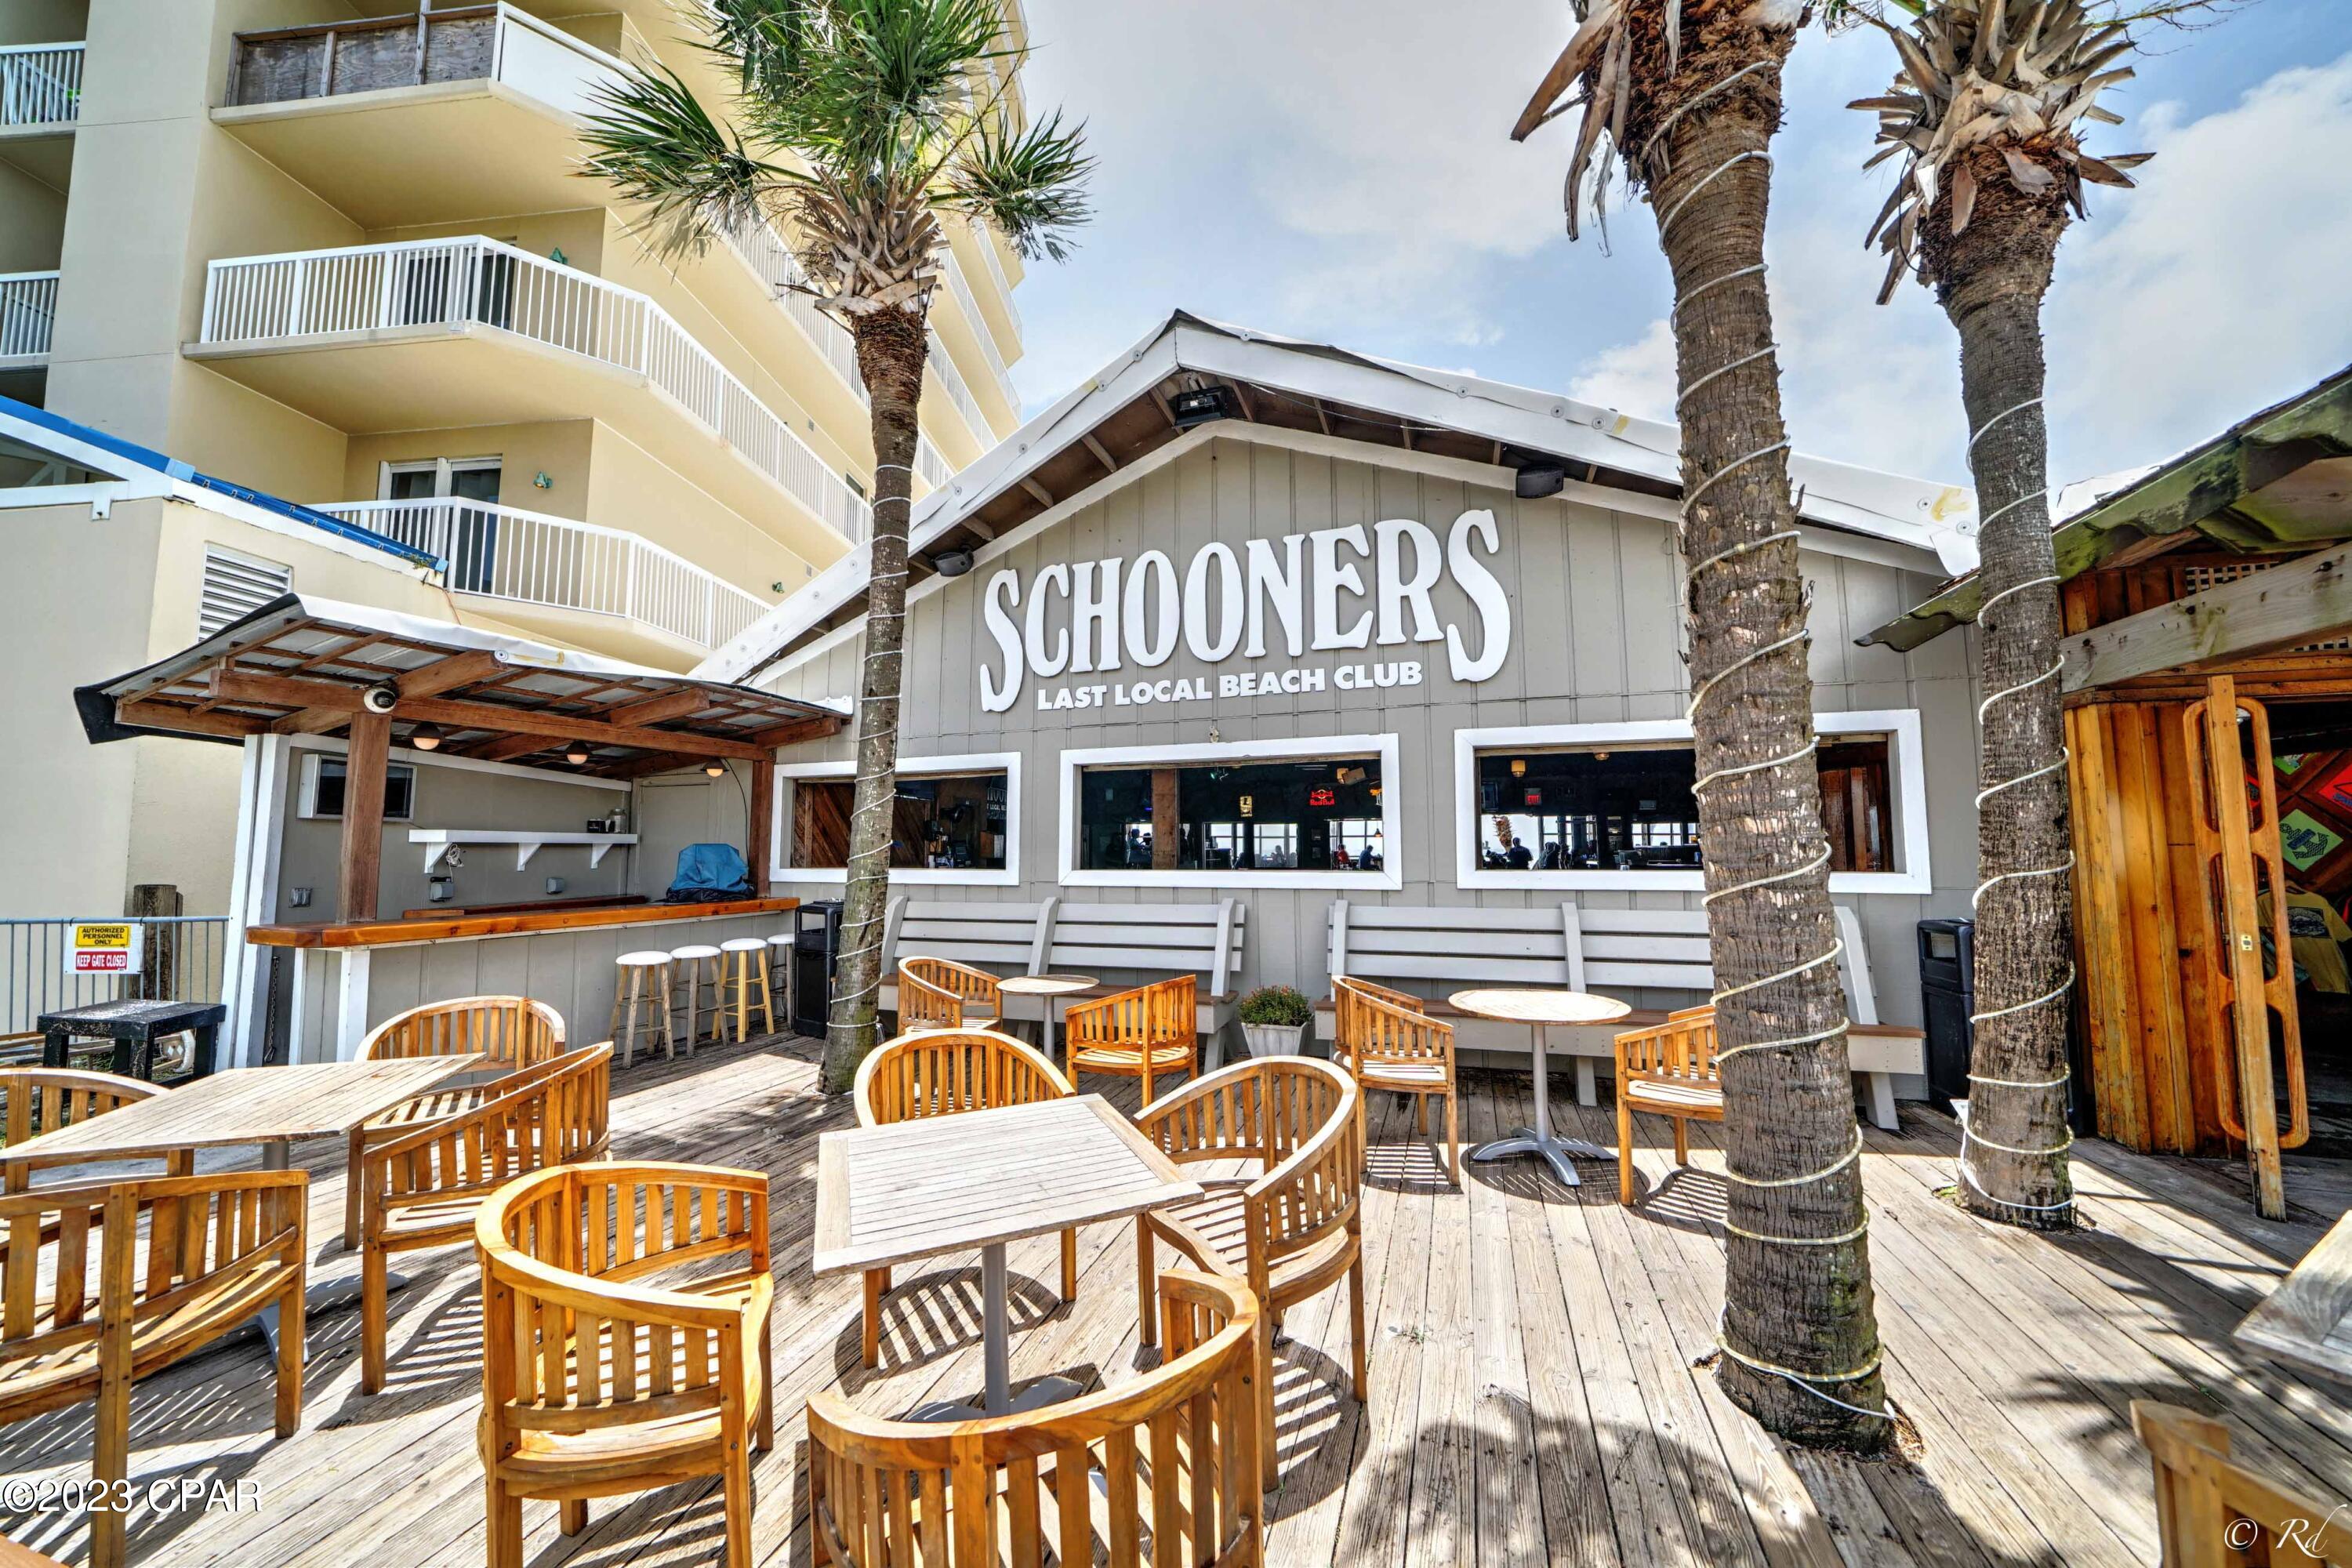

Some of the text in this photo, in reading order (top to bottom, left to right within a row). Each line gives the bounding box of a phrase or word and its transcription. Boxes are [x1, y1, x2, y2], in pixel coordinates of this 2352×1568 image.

[979, 509, 1512, 713] SCHOONERS
[1037, 661, 1423, 710] LAST LOCAL BEACH CLUB
[77, 955, 126, 967] KEEP GATE CLOSED
